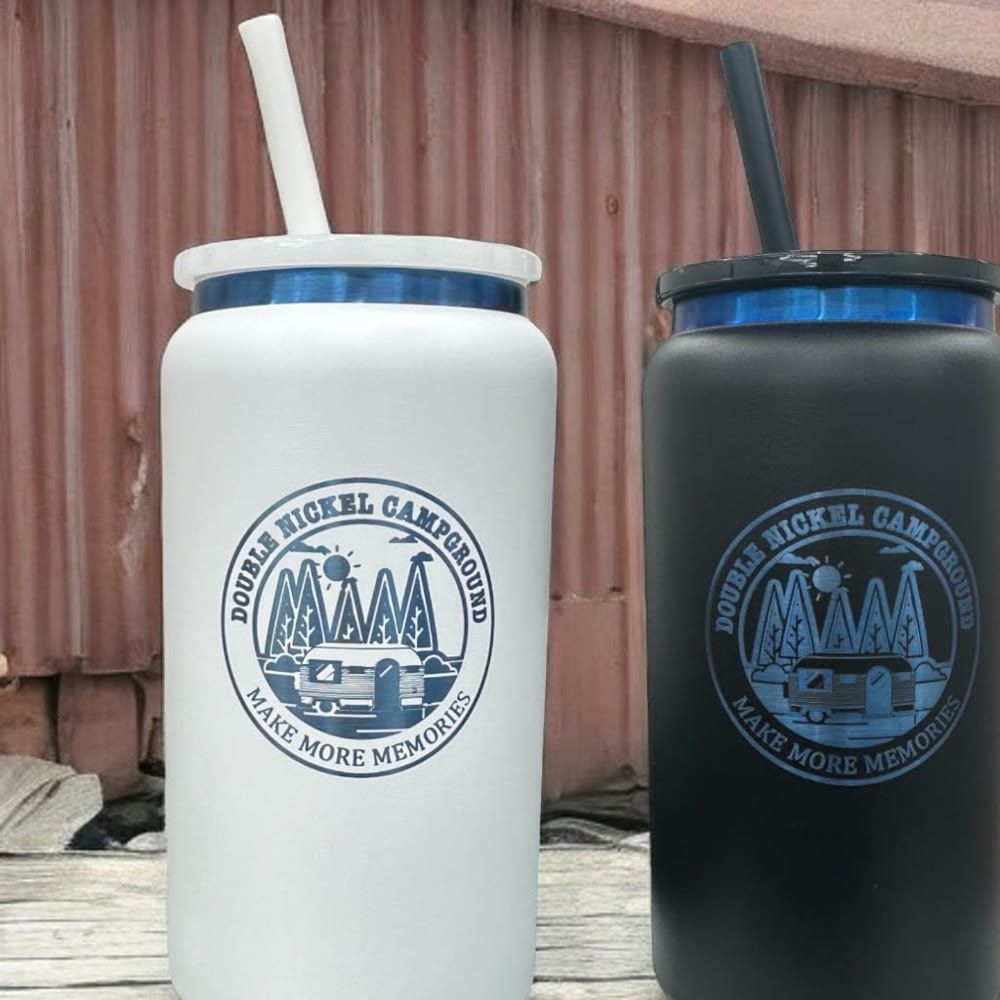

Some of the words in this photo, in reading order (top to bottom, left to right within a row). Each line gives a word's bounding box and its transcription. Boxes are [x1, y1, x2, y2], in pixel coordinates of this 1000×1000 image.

[232, 531, 280, 624] DOUBLE
[274, 493, 374, 539] NICKEL
[382, 495, 487, 624] CAMPGROUND
[716, 543, 765, 634] DOUBLE
[761, 504, 865, 550] NICKEL
[873, 506, 974, 630] CAMPGROUND
[247, 687, 298, 744] MAKE
[299, 735, 365, 767] MORE
[372, 691, 471, 767] MEMORIES
[732, 696, 788, 752] MAKE
[787, 743, 856, 775] MORE
[865, 695, 961, 774] MEMORIES
